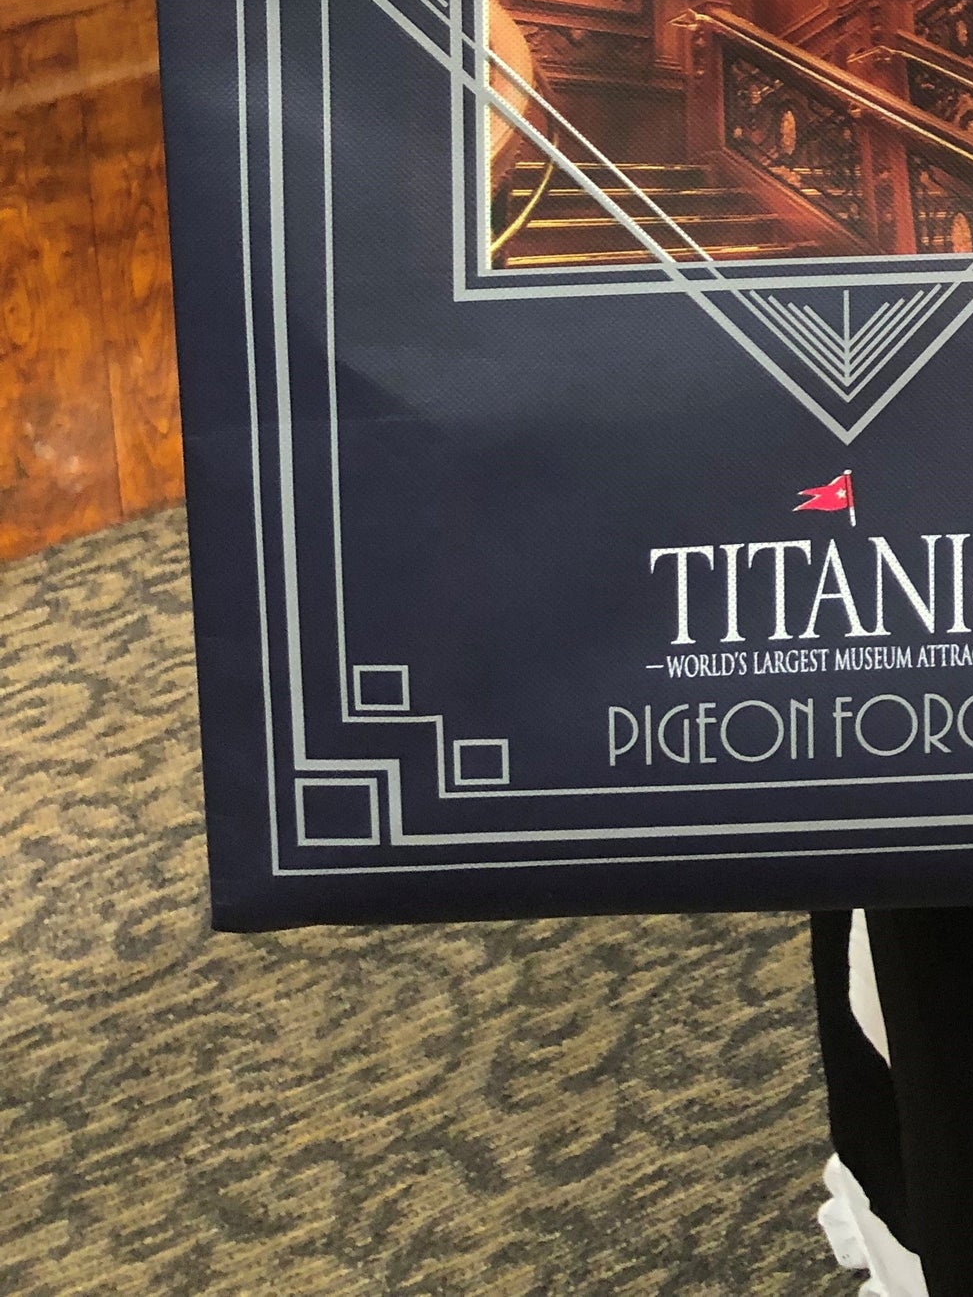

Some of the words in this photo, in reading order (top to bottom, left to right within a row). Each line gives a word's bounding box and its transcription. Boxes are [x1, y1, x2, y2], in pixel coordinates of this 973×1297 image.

[666, 652, 748, 679] WORLD'S
[753, 648, 829, 675] LARGEST
[834, 644, 912, 672] MUSEUM
[608, 698, 815, 767] PIGEON
